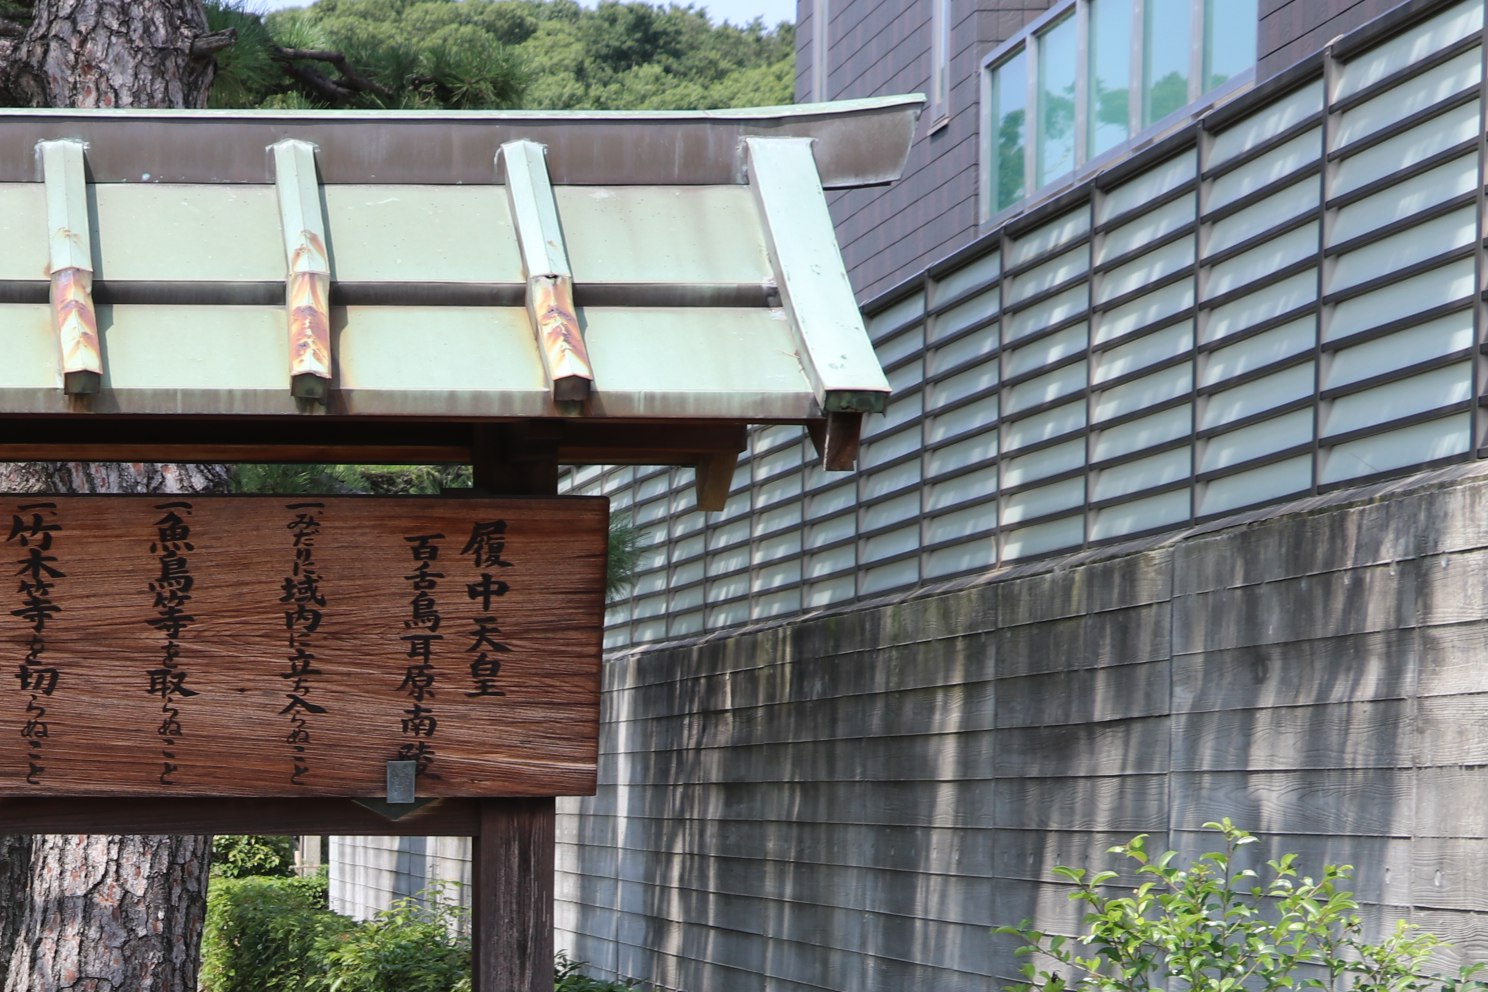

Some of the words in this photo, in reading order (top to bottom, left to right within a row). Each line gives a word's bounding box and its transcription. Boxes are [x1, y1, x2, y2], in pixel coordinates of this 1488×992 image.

[394, 533, 446, 781] 百舌鳥耳原南陵
[459, 519, 515, 697] 履中天皇
